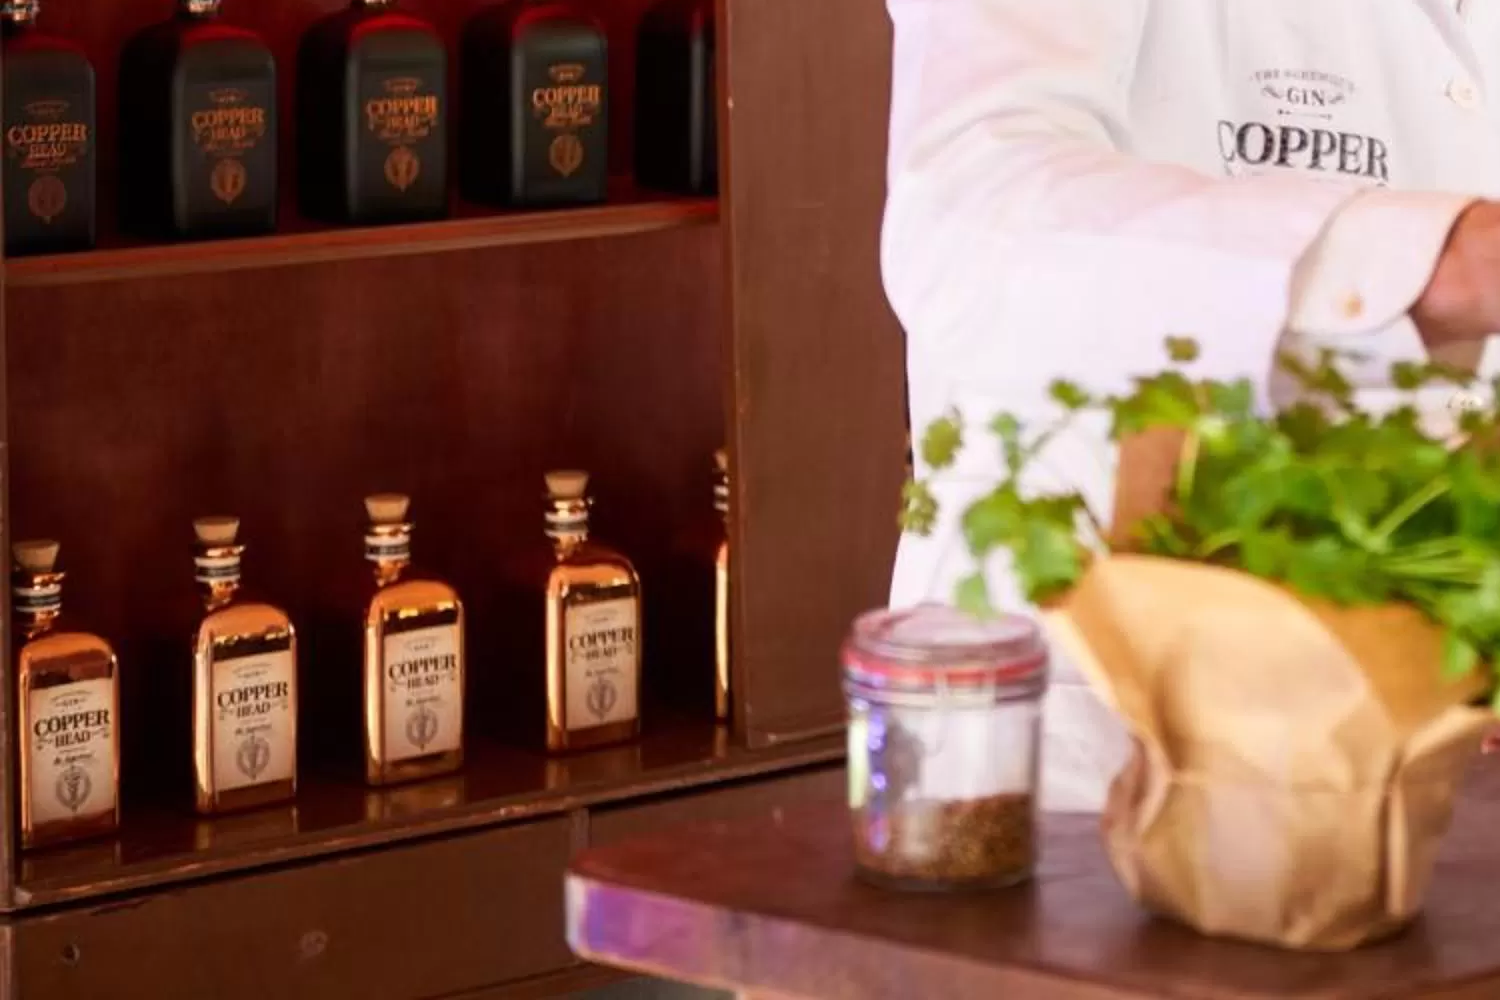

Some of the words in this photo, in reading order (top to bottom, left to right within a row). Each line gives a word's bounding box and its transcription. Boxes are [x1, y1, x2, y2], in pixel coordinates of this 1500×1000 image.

[532, 85, 599, 108] COPPER
[1287, 87, 1326, 106] GIN
[191, 107, 265, 129] COPPER
[7, 122, 87, 146] COPPER
[1218, 119, 1390, 182] COPPER
[389, 654, 455, 680] COPPER
[217, 681, 289, 708] COPPER
[236, 702, 270, 718] HEAD
[33, 708, 110, 737] COPPER
[55, 731, 91, 748] HEAD
